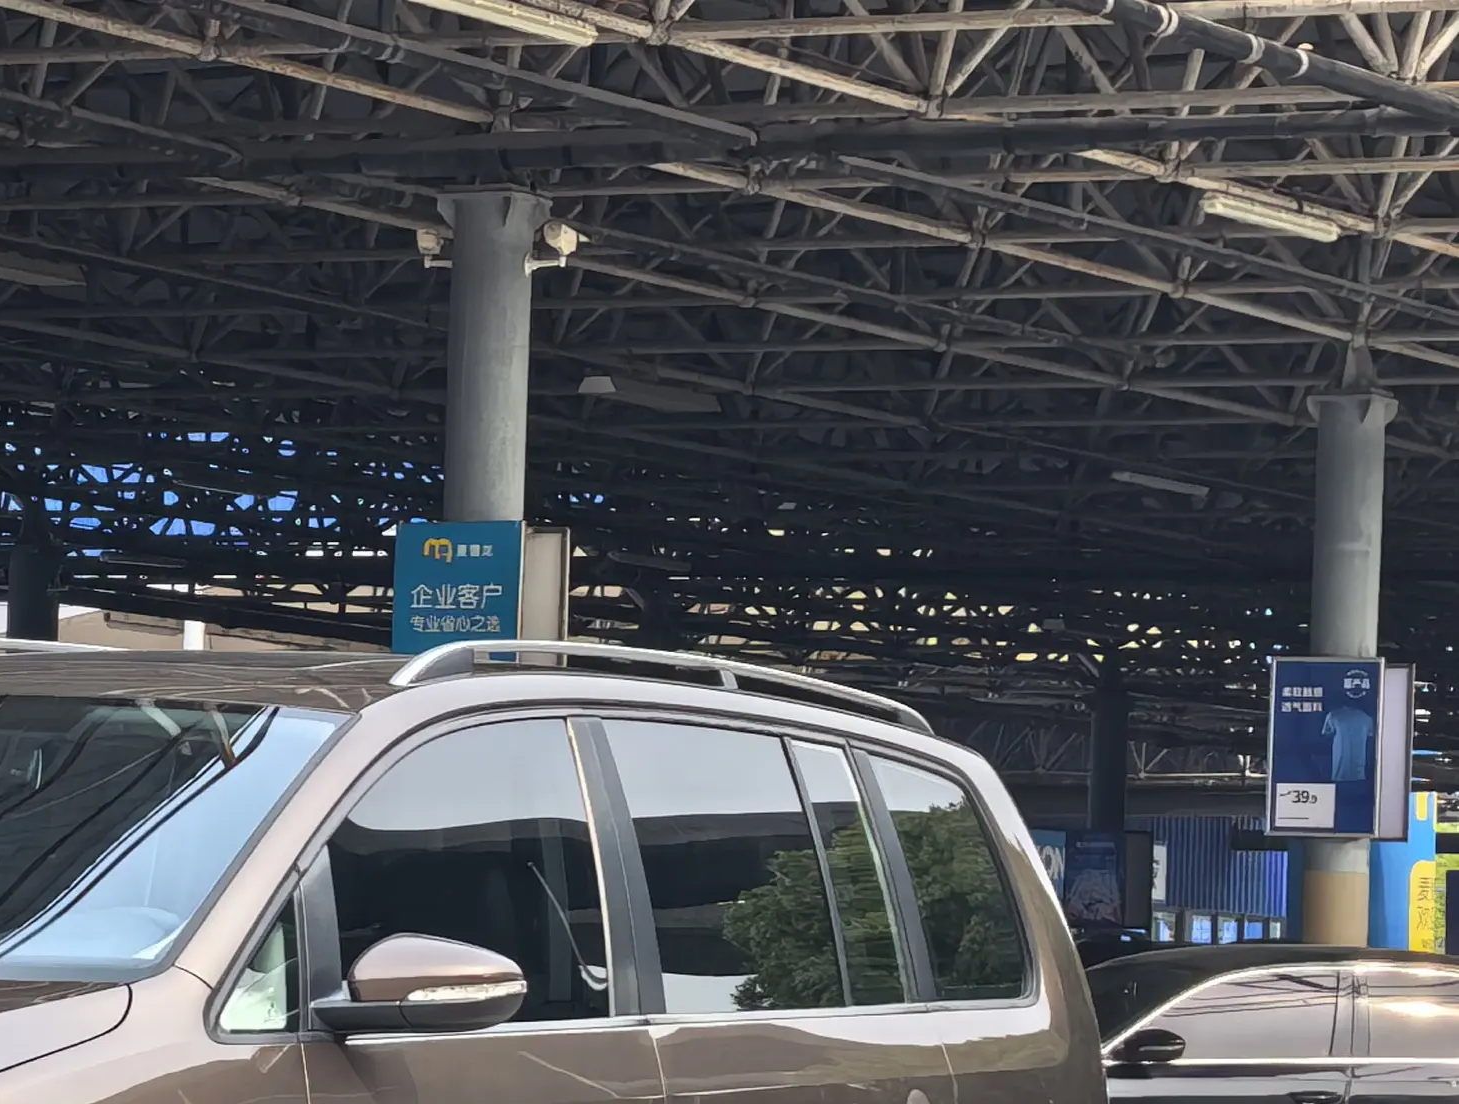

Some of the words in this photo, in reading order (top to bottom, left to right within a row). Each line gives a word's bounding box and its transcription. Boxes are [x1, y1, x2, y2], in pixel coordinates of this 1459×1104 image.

[410, 583, 503, 609] 企业客户
[409, 615, 501, 633] 专业省心之选
